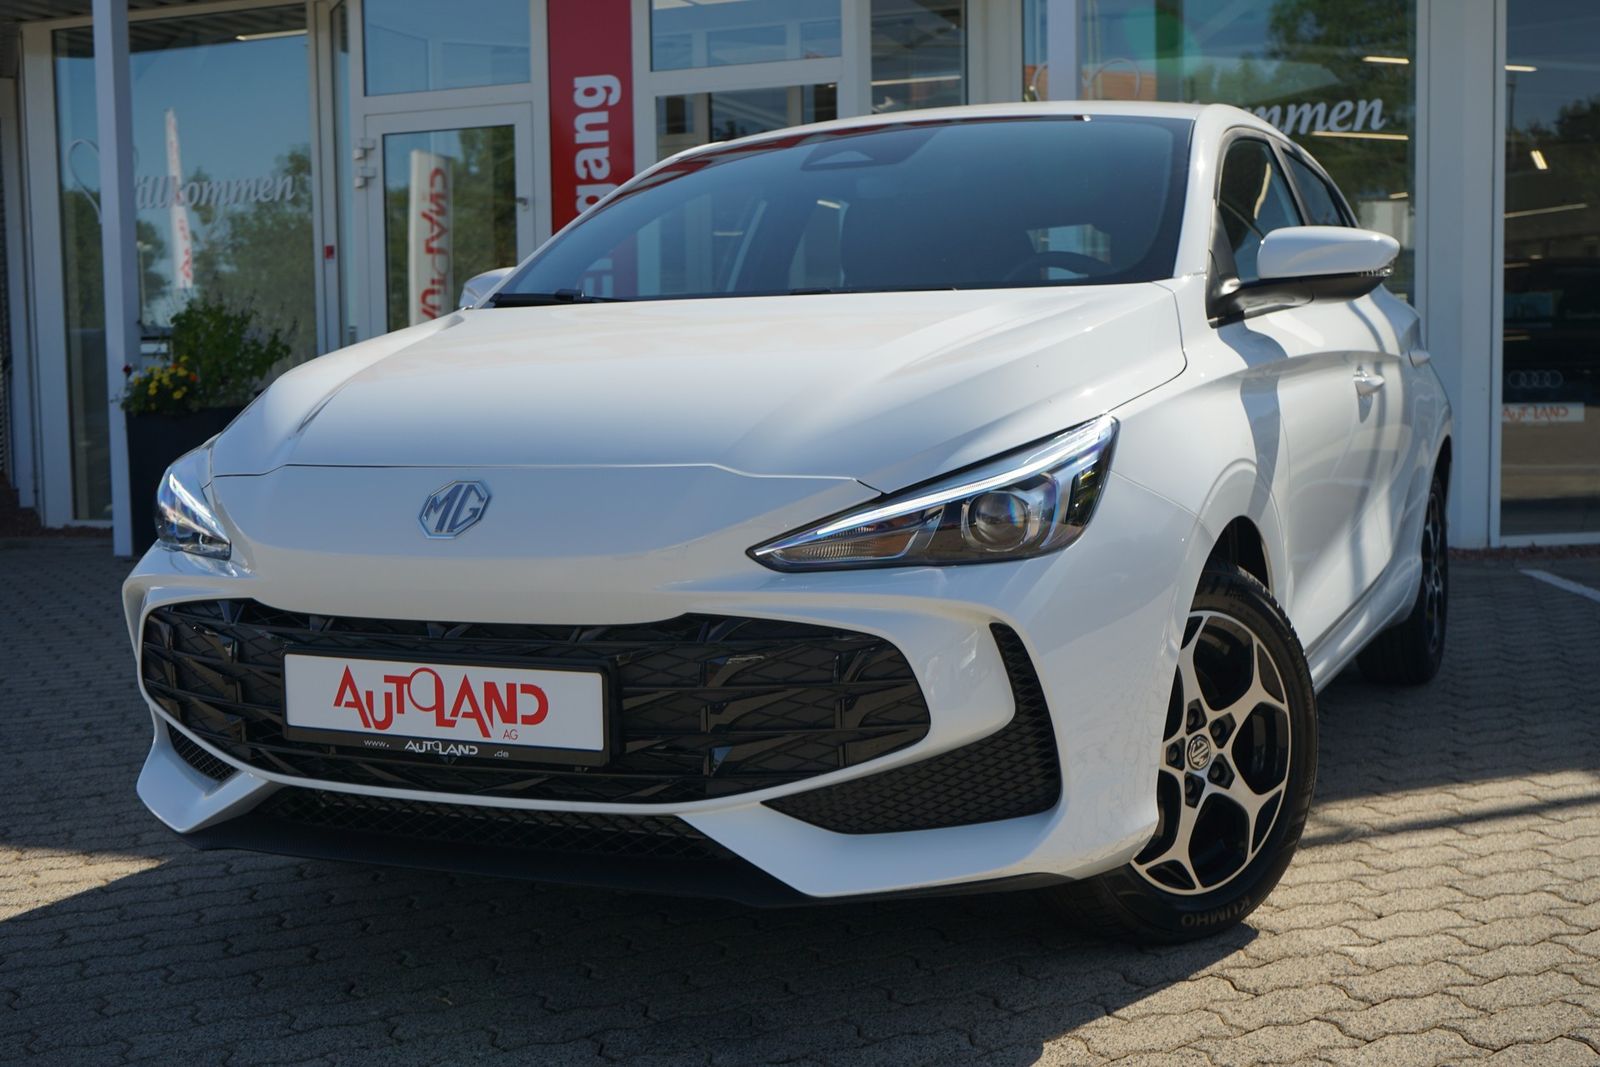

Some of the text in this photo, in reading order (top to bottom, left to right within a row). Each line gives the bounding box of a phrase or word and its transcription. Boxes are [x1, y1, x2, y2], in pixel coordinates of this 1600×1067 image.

[134, 174, 296, 209] illkommen
[422, 483, 486, 533] MG
[333, 664, 549, 739] AUTOLAND
[363, 739, 390, 748] www.
[404, 740, 479, 757] AUTOLAND
[502, 728, 519, 741] AG
[1181, 896, 1250, 927] KUMHO
